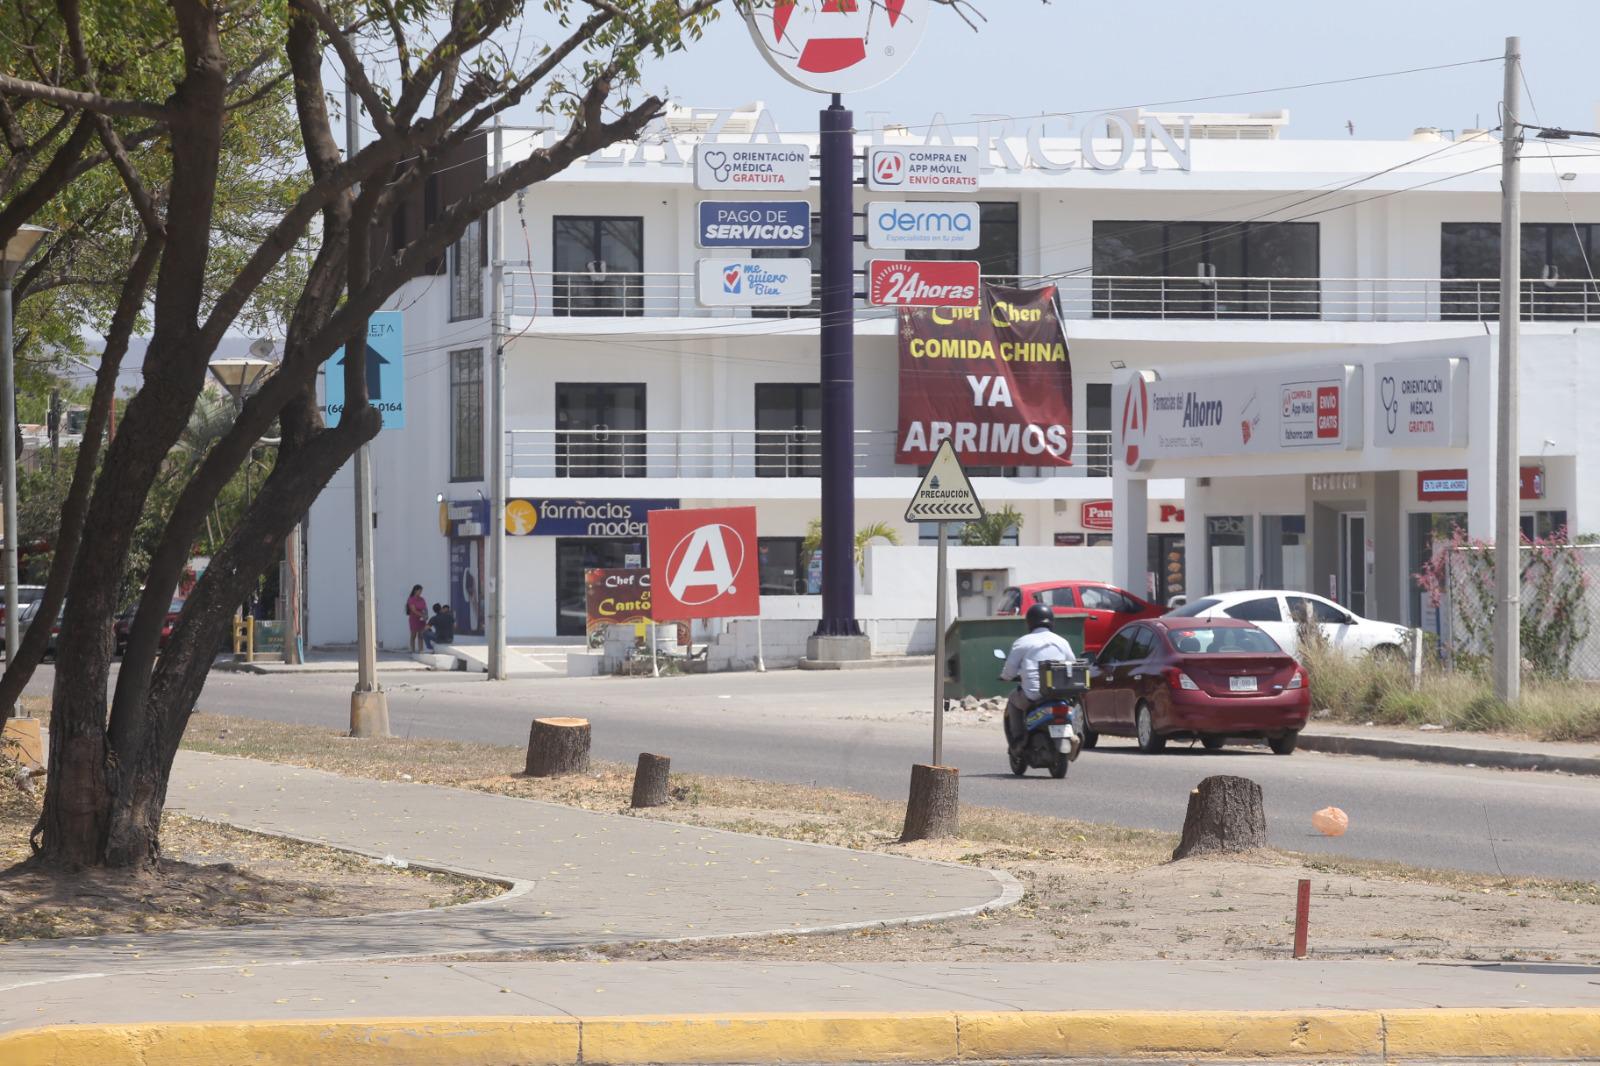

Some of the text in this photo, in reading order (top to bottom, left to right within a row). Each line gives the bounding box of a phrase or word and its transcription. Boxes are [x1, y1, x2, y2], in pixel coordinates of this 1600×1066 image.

[733, 151, 804, 162] ORIENTACIÓN
[909, 153, 967, 162] COMPRA EN
[733, 162, 773, 173] MÉDICA
[909, 162, 962, 174] APP MÓVIL
[733, 173, 785, 183] GRATUITA
[909, 174, 977, 186] ENVÍO GRATIS
[718, 210, 788, 223] PAGO DE
[879, 208, 972, 232] derma
[705, 224, 805, 240] SERVICIOS
[748, 271, 788, 289] quiero
[755, 283, 781, 296] Bien
[991, 301, 1042, 327] Chen
[910, 338, 1066, 362] COMIDA CHINA
[966, 375, 1014, 407] YA
[1401, 376, 1443, 395] ORIENTACIÓN
[1319, 392, 1337, 409] ENVÍO
[1410, 400, 1433, 415] MÉDICA
[1183, 392, 1223, 428] Ahorro
[1292, 402, 1301, 416] App
[1318, 415, 1338, 430] GRATIS
[1408, 420, 1435, 433] GRATUITA
[902, 421, 1068, 456] ABRIMOS
[920, 488, 969, 499] PRECAUCIÓN
[540, 499, 632, 519] farmacias
[605, 575, 635, 588] Chef
